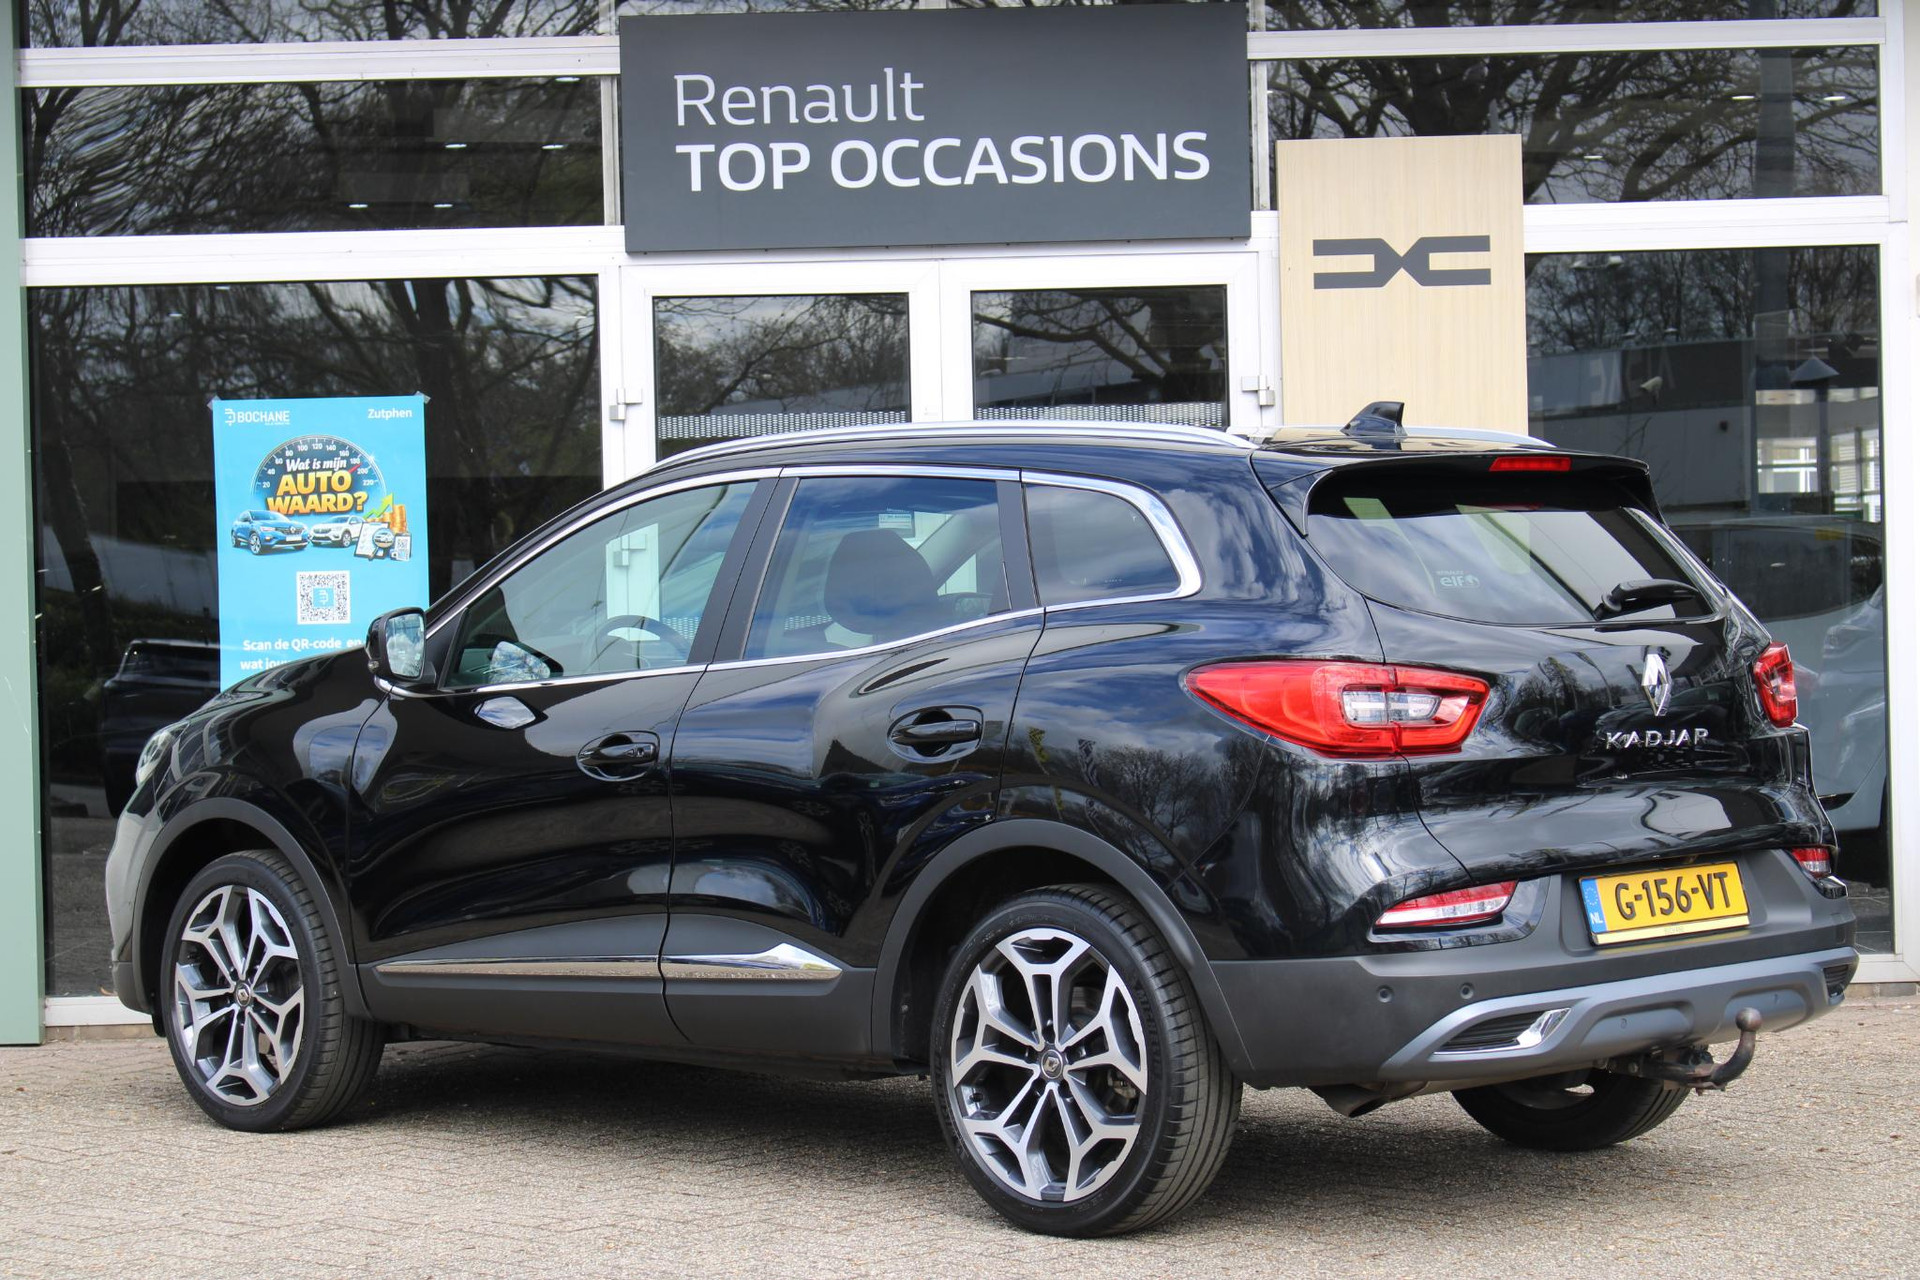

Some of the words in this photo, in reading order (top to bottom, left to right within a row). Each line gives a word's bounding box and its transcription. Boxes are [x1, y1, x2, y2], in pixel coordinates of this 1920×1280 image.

[674, 67, 925, 127] Renault
[675, 142, 811, 192] TOP
[830, 131, 1210, 189] OCCASIONS
[237, 410, 290, 423] BOCHANE
[368, 407, 413, 421] Zutphen
[262, 481, 271, 489] 20
[297, 444, 308, 452] 100
[357, 467, 369, 475] 200
[286, 458, 308, 473] Wat
[312, 458, 322, 470] is
[322, 456, 348, 472] mijn
[276, 469, 352, 496] AUTO
[266, 491, 369, 515] WAARD?
[1439, 575, 1465, 587] elf
[243, 639, 272, 651] Scan
[274, 638, 290, 650] de
[291, 637, 342, 652] QR-code
[346, 639, 362, 647] en
[240, 658, 264, 671] wat
[1605, 727, 1710, 750] KADJAR
[1614, 871, 1731, 921] G-156-VT
[1590, 911, 1604, 925] NL
